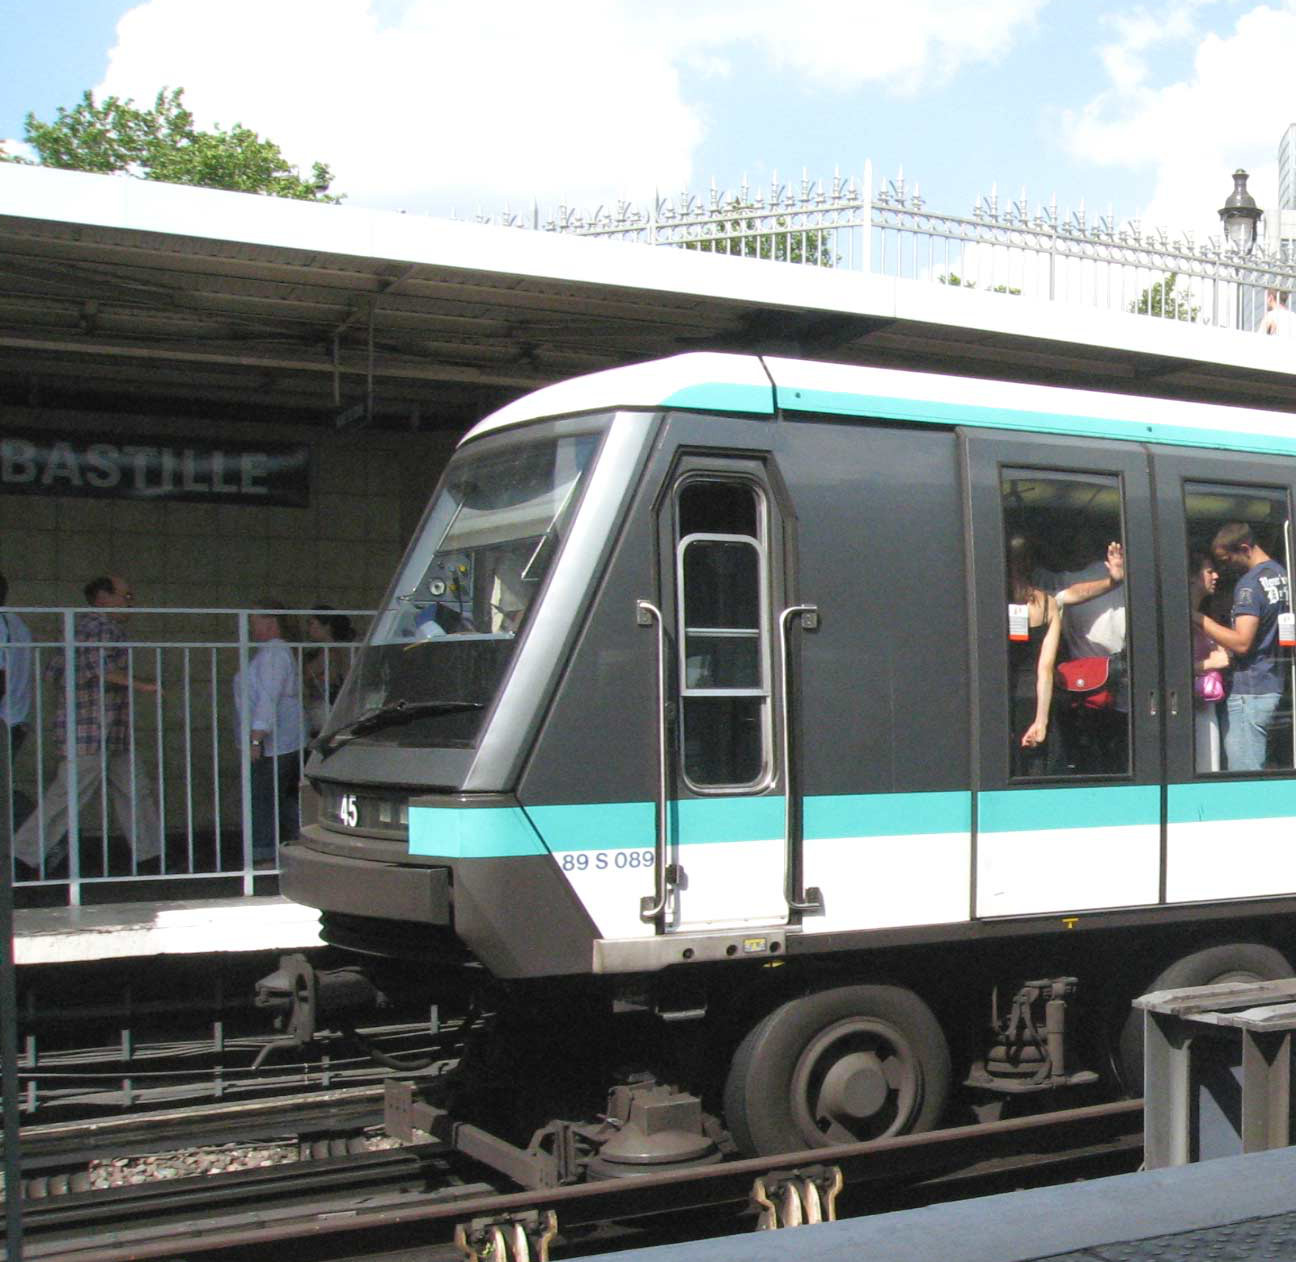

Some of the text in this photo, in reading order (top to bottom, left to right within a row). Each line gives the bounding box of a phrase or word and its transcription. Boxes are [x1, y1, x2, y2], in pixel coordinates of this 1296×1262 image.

[0, 438, 271, 495] BASTILLE
[340, 795, 358, 827] 45
[562, 850, 655, 871] 89 S 089
